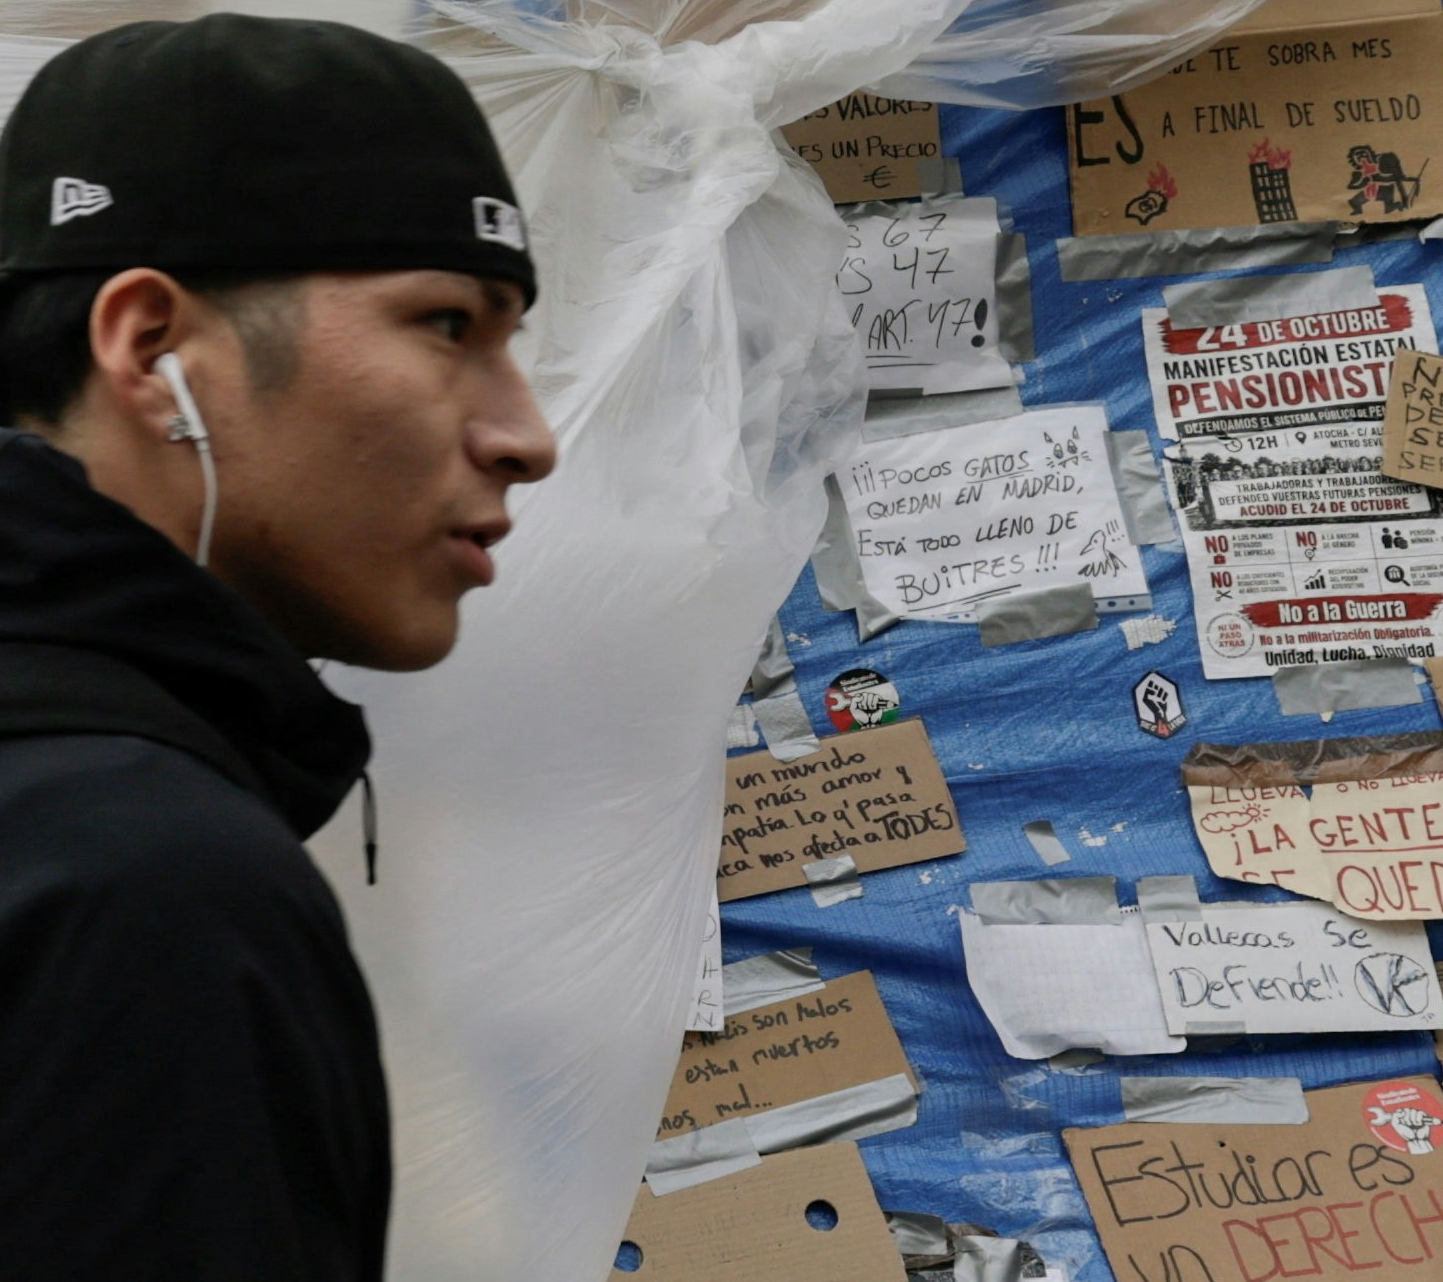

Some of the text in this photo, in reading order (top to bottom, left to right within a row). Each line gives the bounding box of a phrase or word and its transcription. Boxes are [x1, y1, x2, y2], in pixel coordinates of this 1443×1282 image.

[1267, 38, 1394, 67] SOBRA MES
[1194, 93, 1421, 134] FINAL DE SUELDO
[1259, 321, 1286, 343] DE
[1289, 309, 1392, 339] OCTUBRE
[1164, 343, 1329, 381] MANIFESTACIÓN
[1184, 410, 1315, 434] DEFENDAMOS SISTEMA
[1248, 436, 1279, 450] 12H
[964, 451, 1031, 479] GATOS
[867, 483, 984, 520] QUEDAN EN
[1240, 498, 1411, 517] ACUDID 24 OCTUBRE
[975, 511, 1079, 544] LLENO DE
[1345, 600, 1407, 619] Guerra
[1298, 628, 1371, 643] militarización
[770, 749, 867, 785] mundo
[754, 772, 883, 812] más amor
[856, 791, 917, 821] pasa
[803, 802, 956, 863] afecta TODES
[1162, 923, 1296, 950] Vallecas
[1090, 1139, 1415, 1228] Estudiar es
